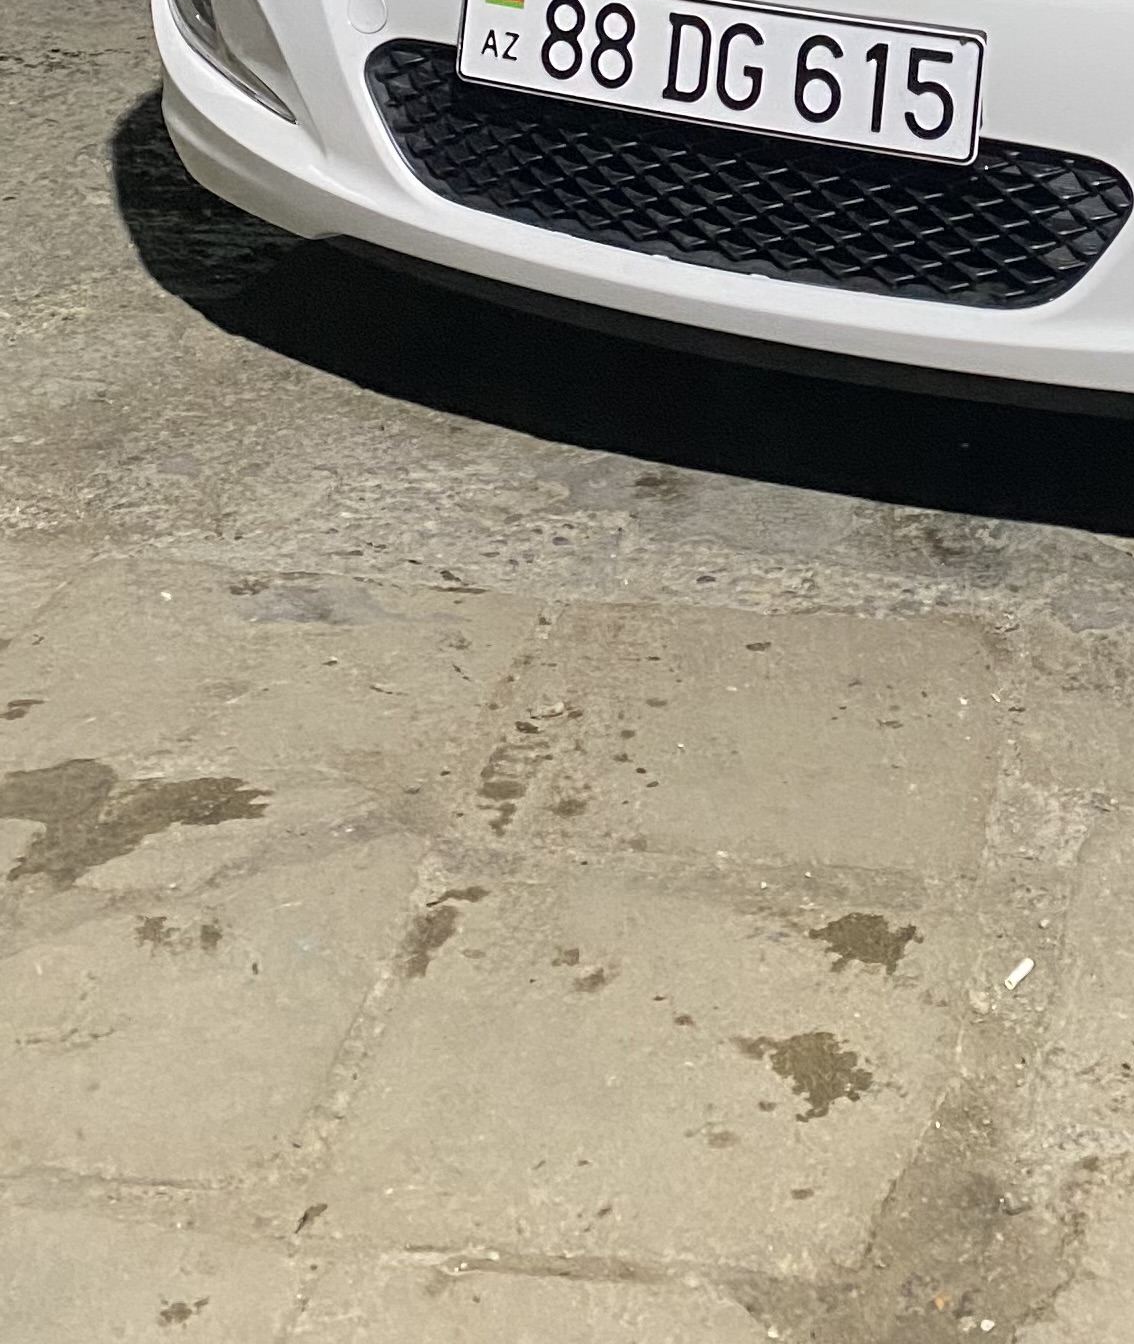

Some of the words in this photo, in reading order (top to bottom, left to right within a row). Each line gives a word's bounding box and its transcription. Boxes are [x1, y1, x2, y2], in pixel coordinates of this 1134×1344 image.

[481, 29, 520, 63] AZ
[662, 12, 765, 111] DG
[794, 34, 955, 140] 615
